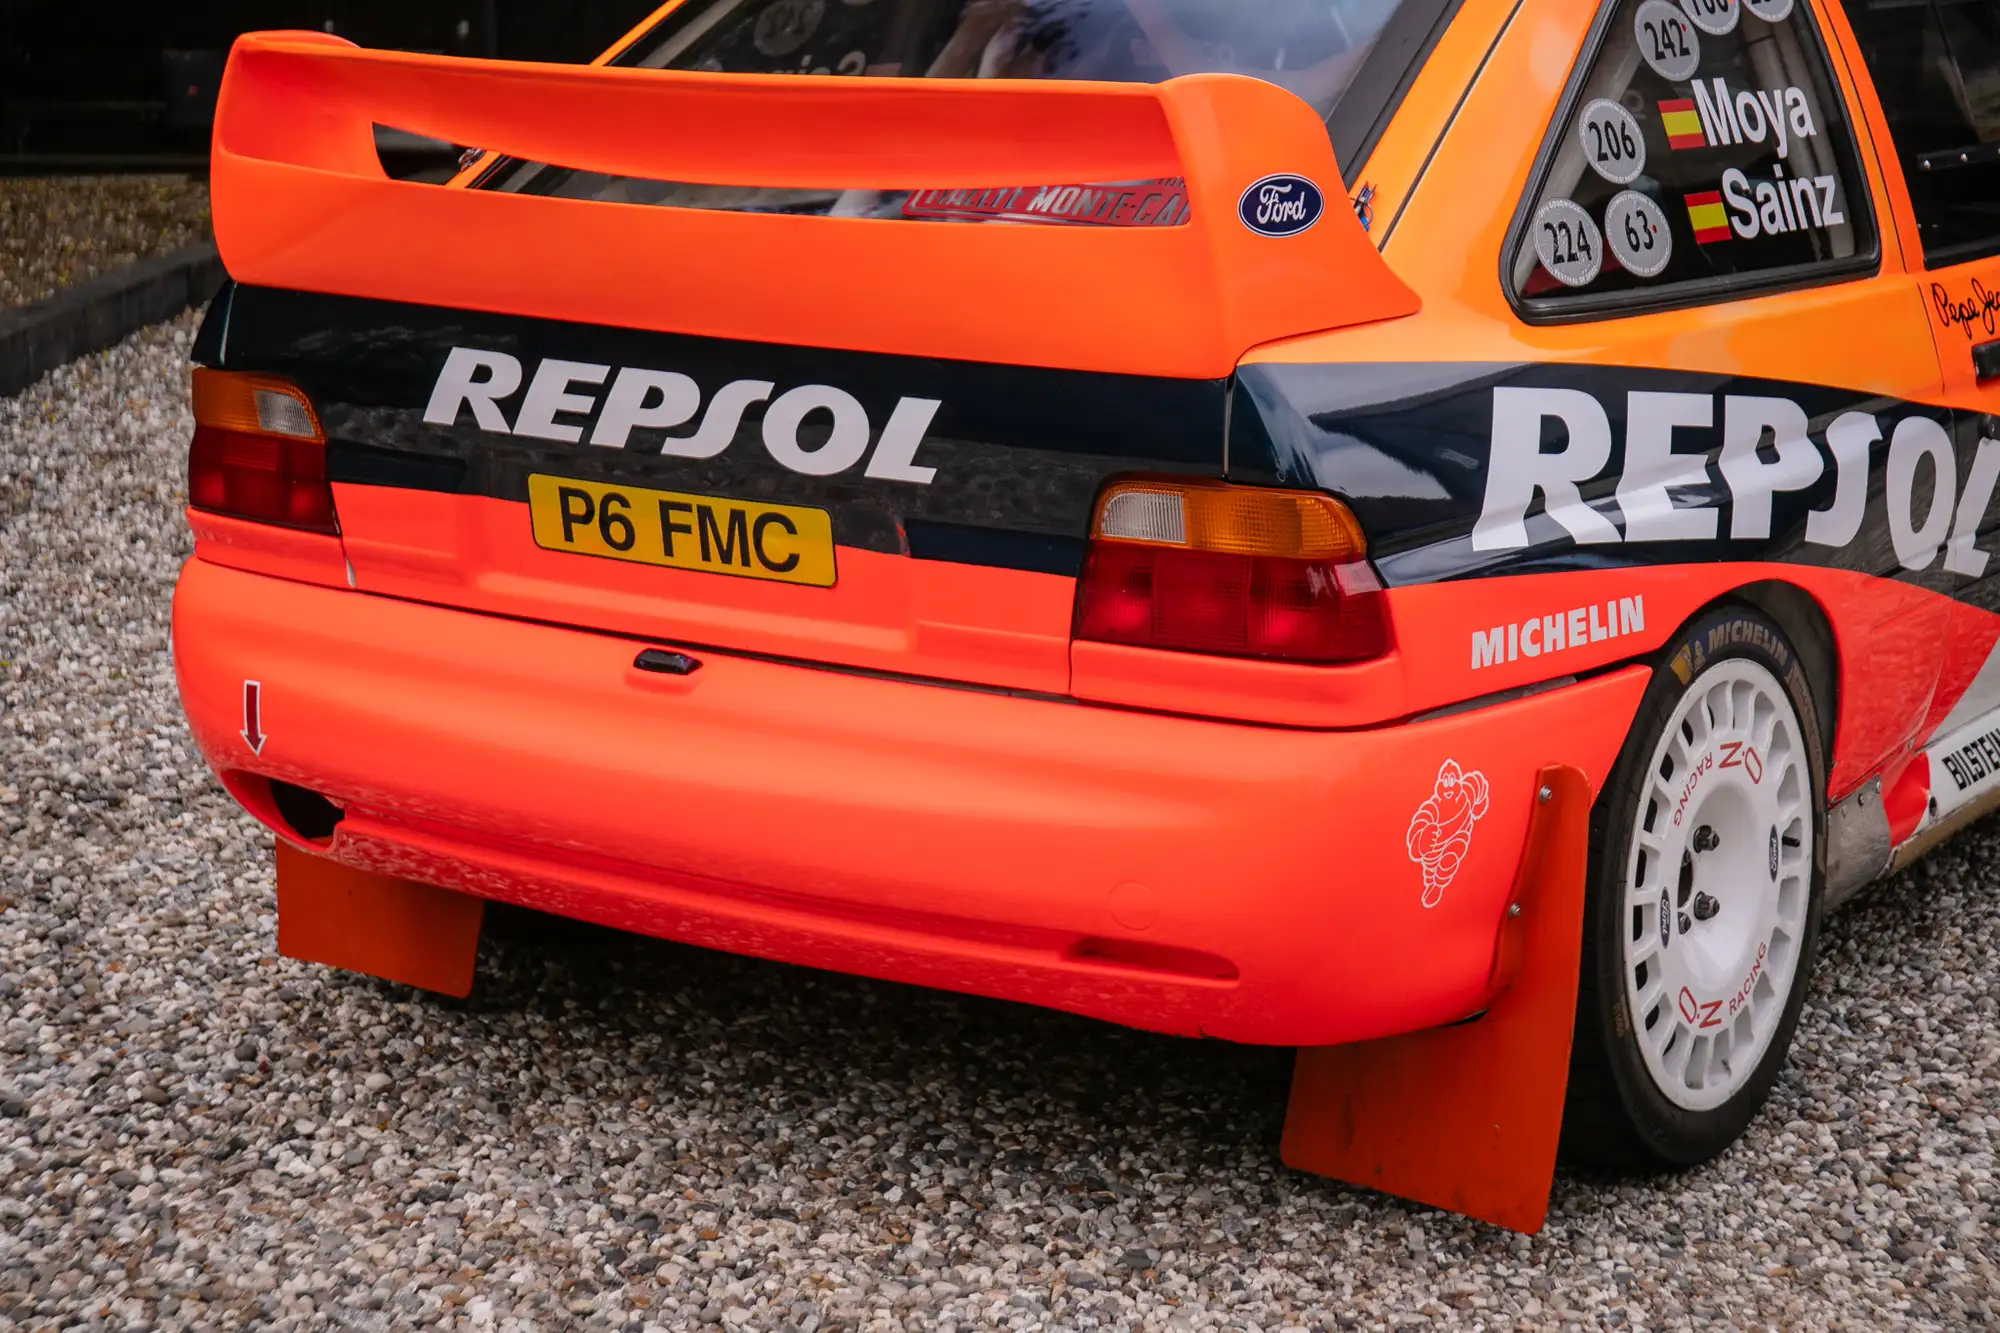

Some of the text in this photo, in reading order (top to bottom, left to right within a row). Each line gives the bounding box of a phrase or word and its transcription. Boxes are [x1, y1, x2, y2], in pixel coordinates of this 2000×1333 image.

[1644, 18, 1691, 61] 242
[1588, 119, 1636, 162] 206
[1691, 77, 1817, 159] Moya
[1026, 185, 1191, 227] MONTE-CA
[1256, 183, 1307, 225] Ford
[1624, 209, 1654, 253] 63
[1722, 164, 1845, 239] Sainz
[1543, 219, 1593, 265] 224
[1931, 282, 1980, 340] Pepe
[423, 346, 941, 485] REPSOL
[1472, 386, 2000, 578] REPSOL
[558, 486, 801, 573] P6 FMC
[1471, 594, 1646, 670] MICHELIN
[1708, 620, 1789, 667] MICHELIN
[1673, 752, 1713, 827] RACING
[1729, 941, 1767, 1016] RACING
